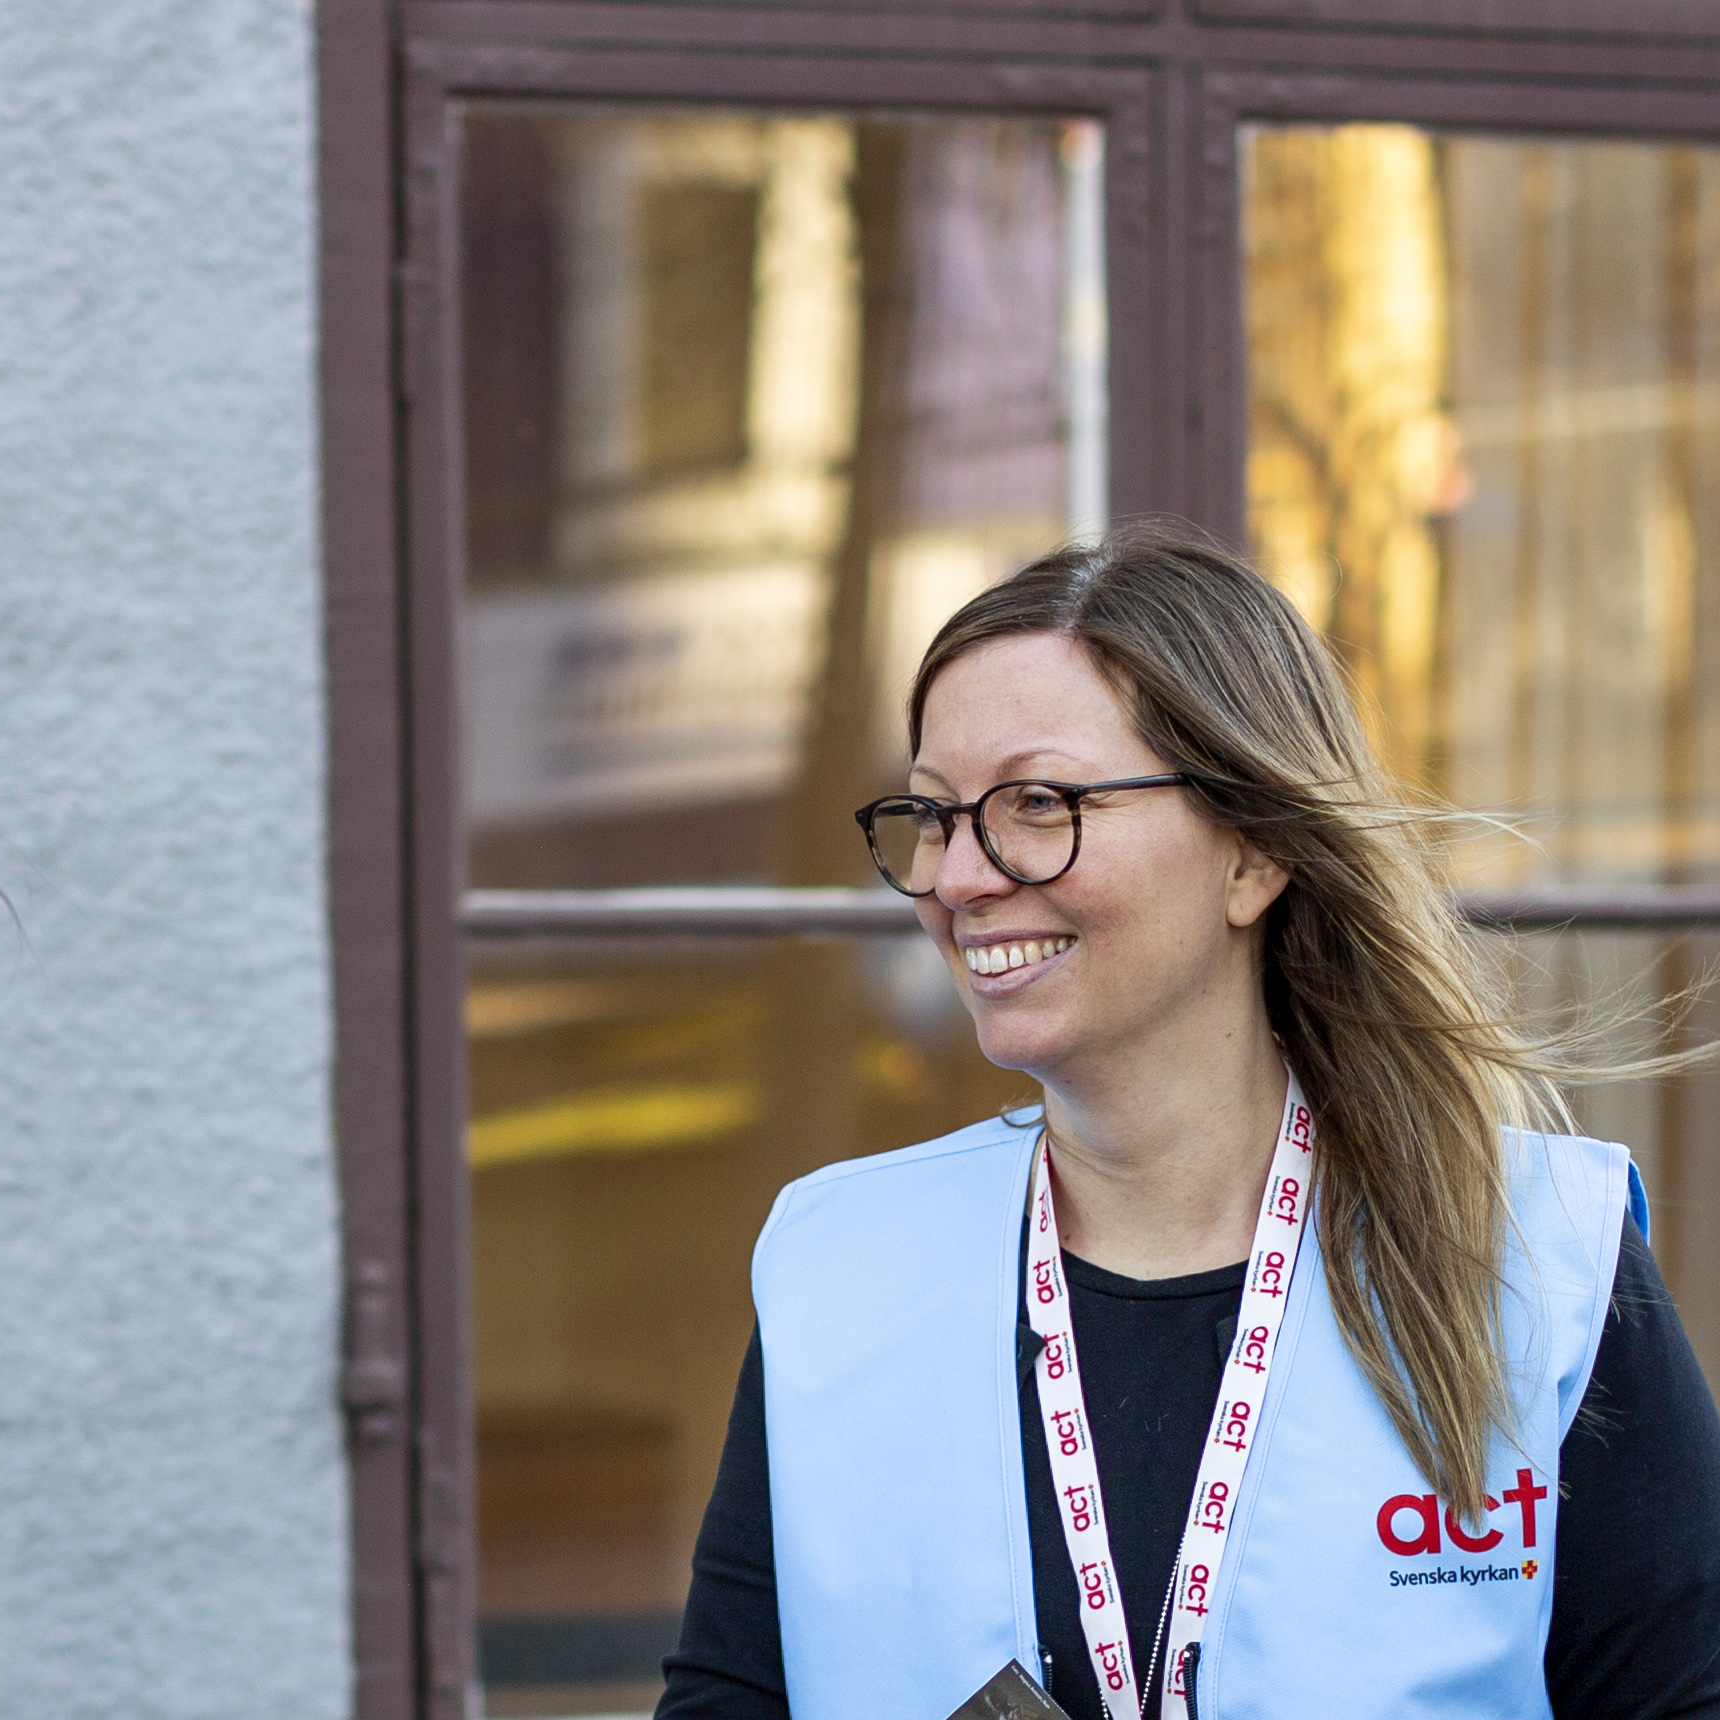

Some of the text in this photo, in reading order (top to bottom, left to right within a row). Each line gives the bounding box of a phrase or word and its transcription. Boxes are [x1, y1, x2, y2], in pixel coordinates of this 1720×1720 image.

[1292, 1106, 1311, 1153] act
[1276, 1178, 1299, 1226] act
[1033, 1260, 1054, 1304] act
[1260, 1251, 1285, 1298] act
[1044, 1334, 1064, 1379] act
[1243, 1326, 1268, 1374] act
[1050, 1410, 1078, 1456] act
[1223, 1402, 1250, 1452] act
[1064, 1486, 1090, 1532] act
[1202, 1482, 1229, 1533] act
[1377, 1468, 1547, 1556] act
[1080, 1562, 1105, 1610] act
[1186, 1564, 1209, 1617] act
[1390, 1564, 1519, 1586] Svenska kyrkan
[1095, 1642, 1123, 1690] act
